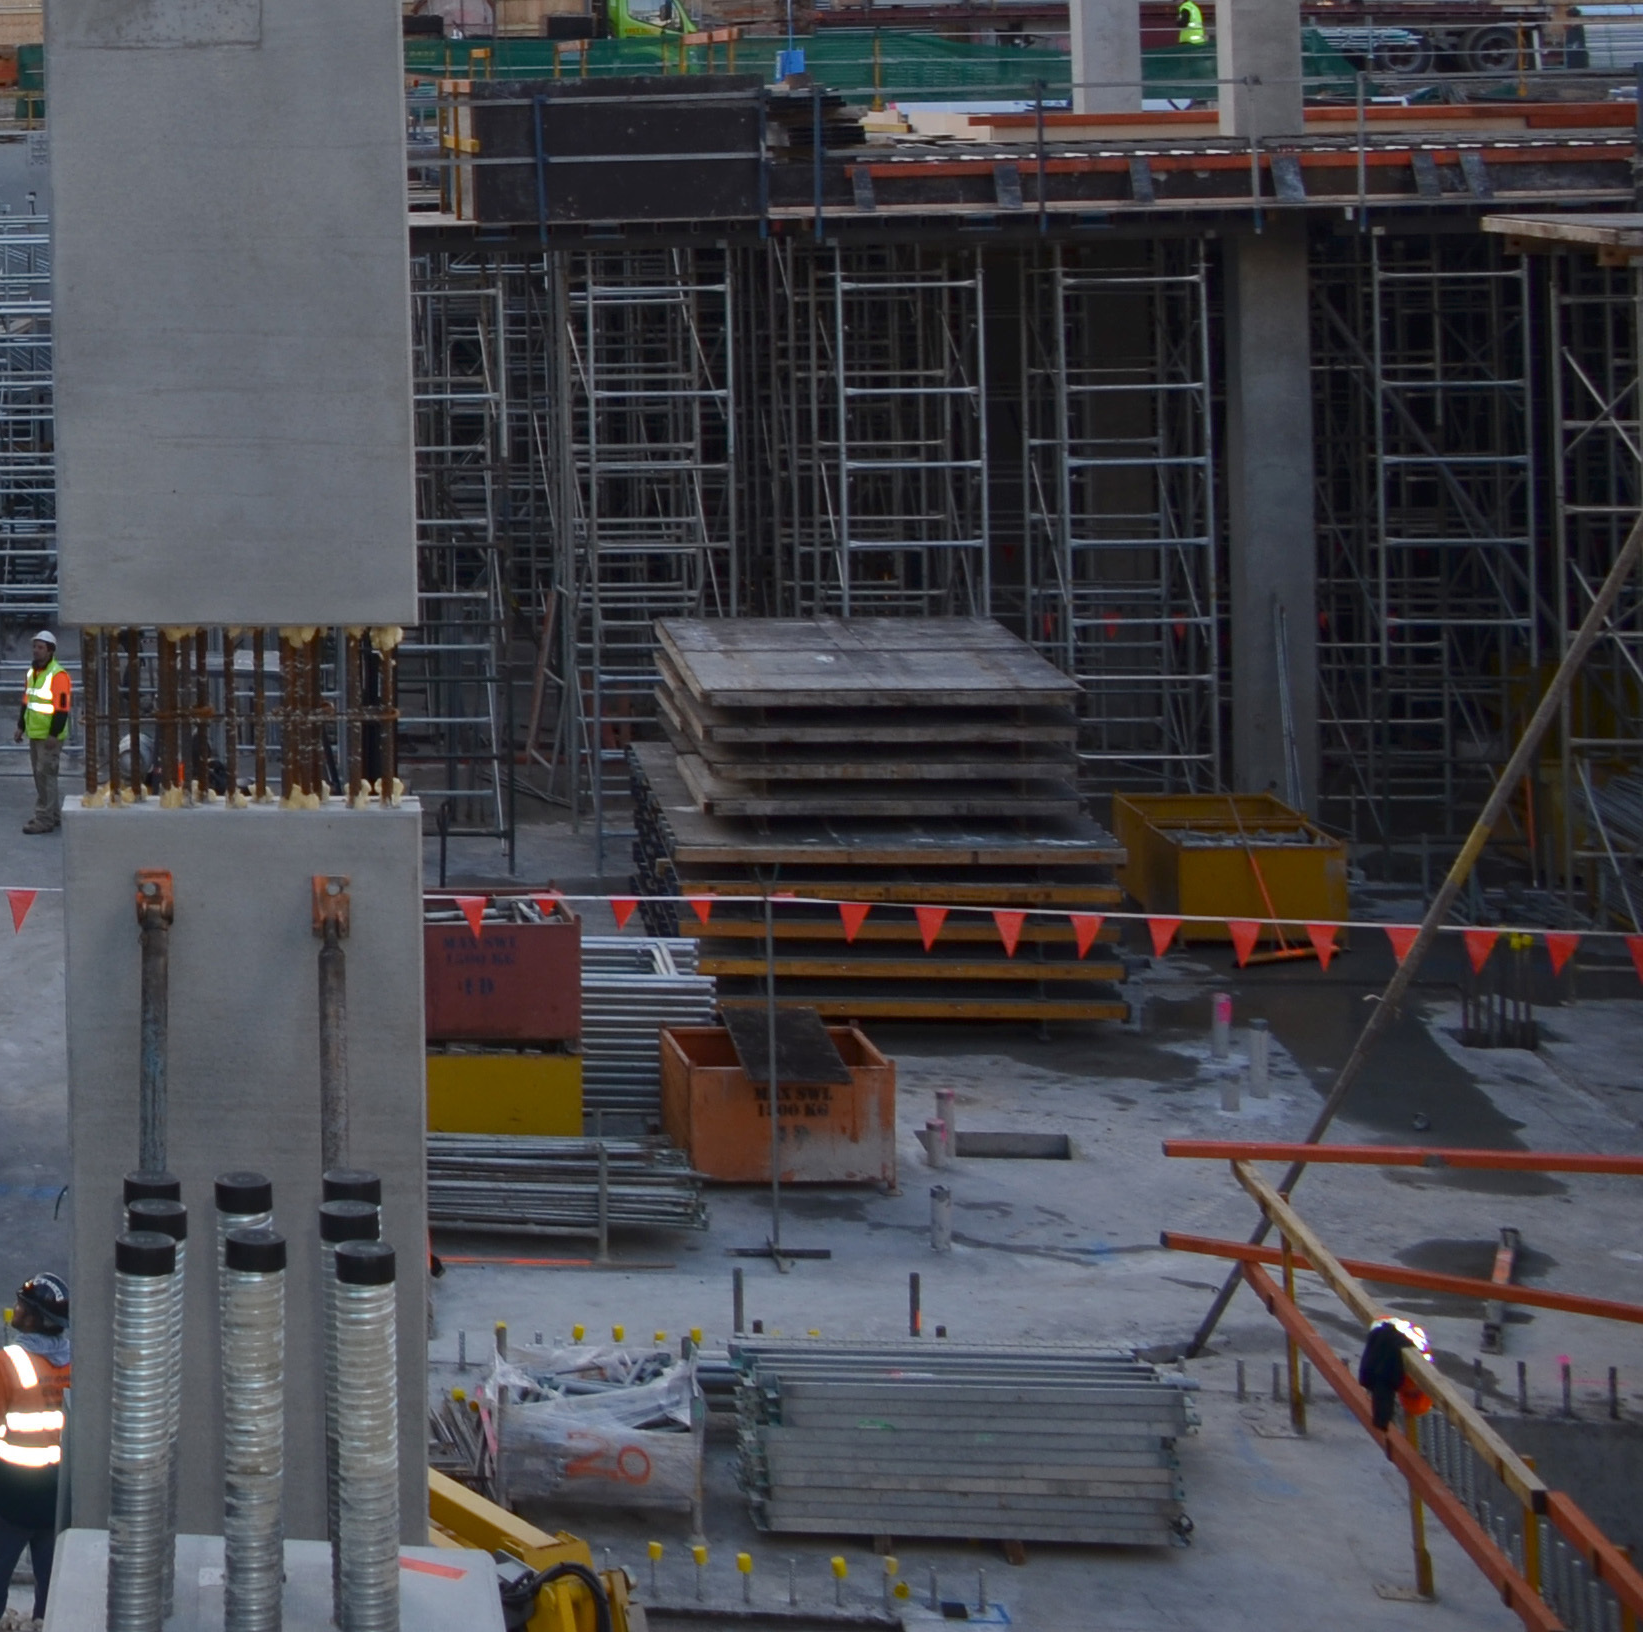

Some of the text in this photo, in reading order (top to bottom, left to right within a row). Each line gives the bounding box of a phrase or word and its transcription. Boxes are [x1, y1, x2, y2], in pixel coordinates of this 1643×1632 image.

[754, 1086, 833, 1101] MX SWL
[805, 1103, 829, 1117] KG
